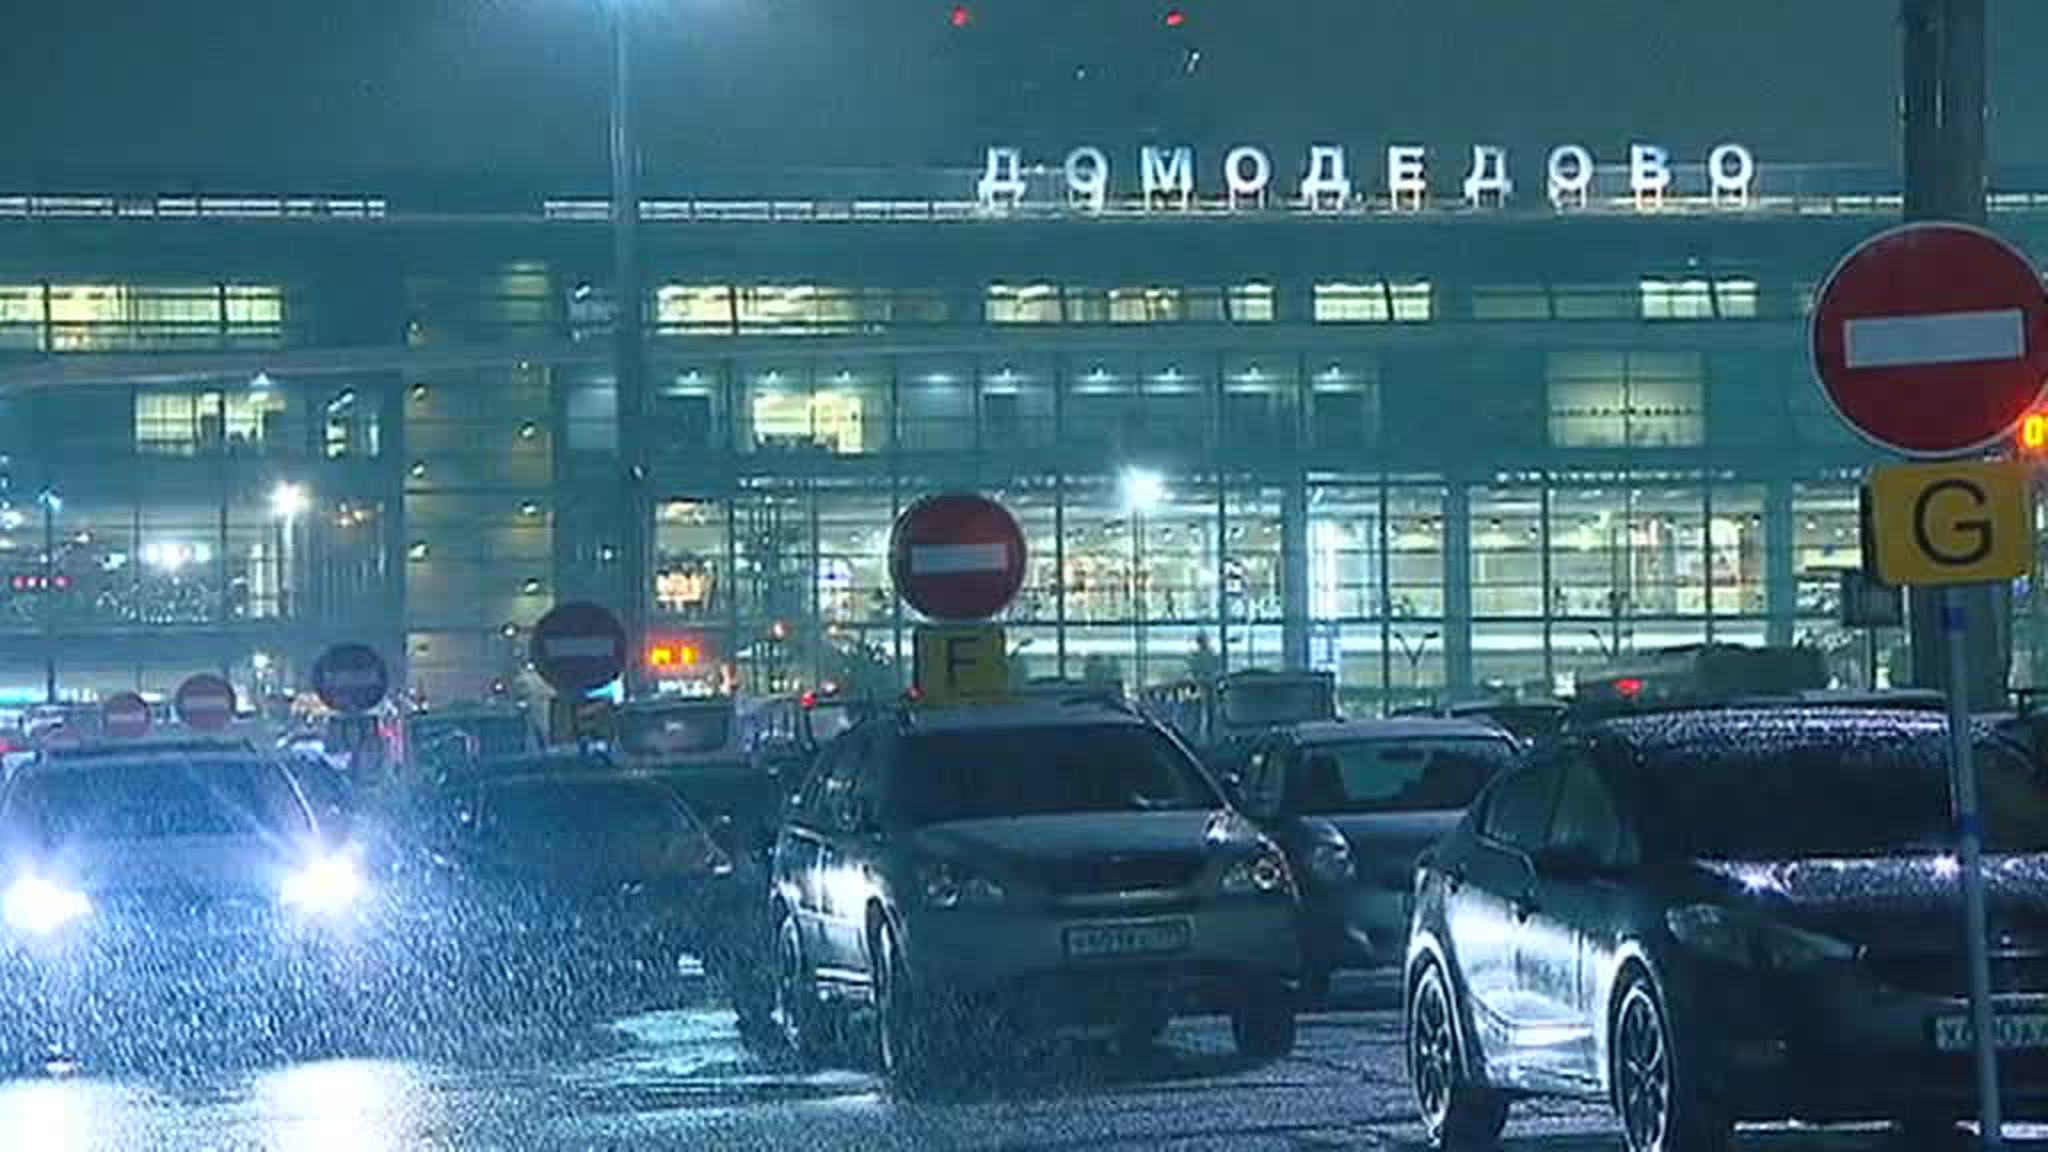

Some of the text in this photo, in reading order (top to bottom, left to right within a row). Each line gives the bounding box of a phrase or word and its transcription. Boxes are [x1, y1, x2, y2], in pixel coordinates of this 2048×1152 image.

[978, 144, 1753, 198] ДОМОДЕДОВО
[1912, 477, 1993, 566] G
[946, 635, 979, 688] F
